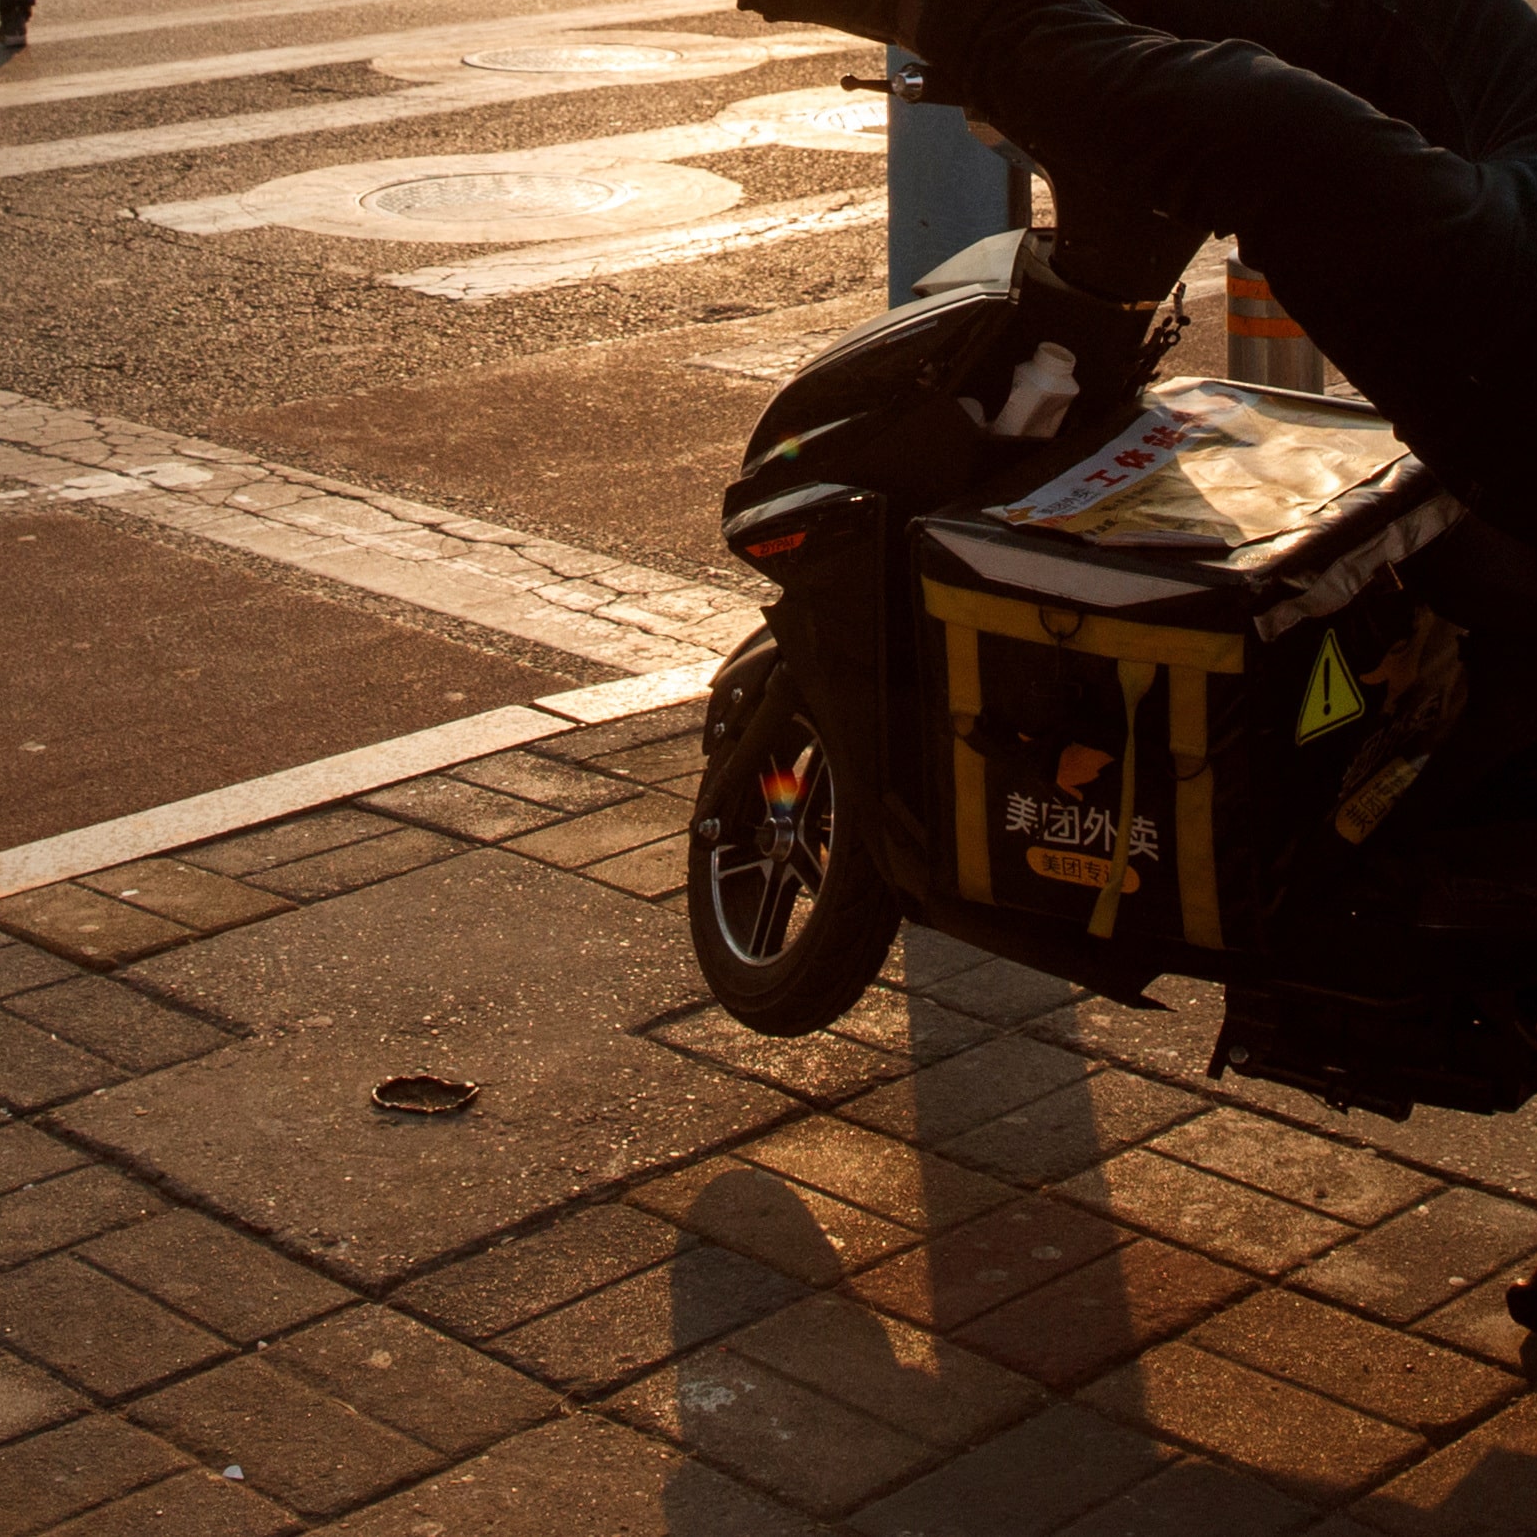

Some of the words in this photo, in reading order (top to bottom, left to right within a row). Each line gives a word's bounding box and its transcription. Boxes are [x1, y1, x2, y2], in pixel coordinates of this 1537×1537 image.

[1004, 791, 1160, 862] 美团外卖
[1041, 853, 1111, 884] 美团专
